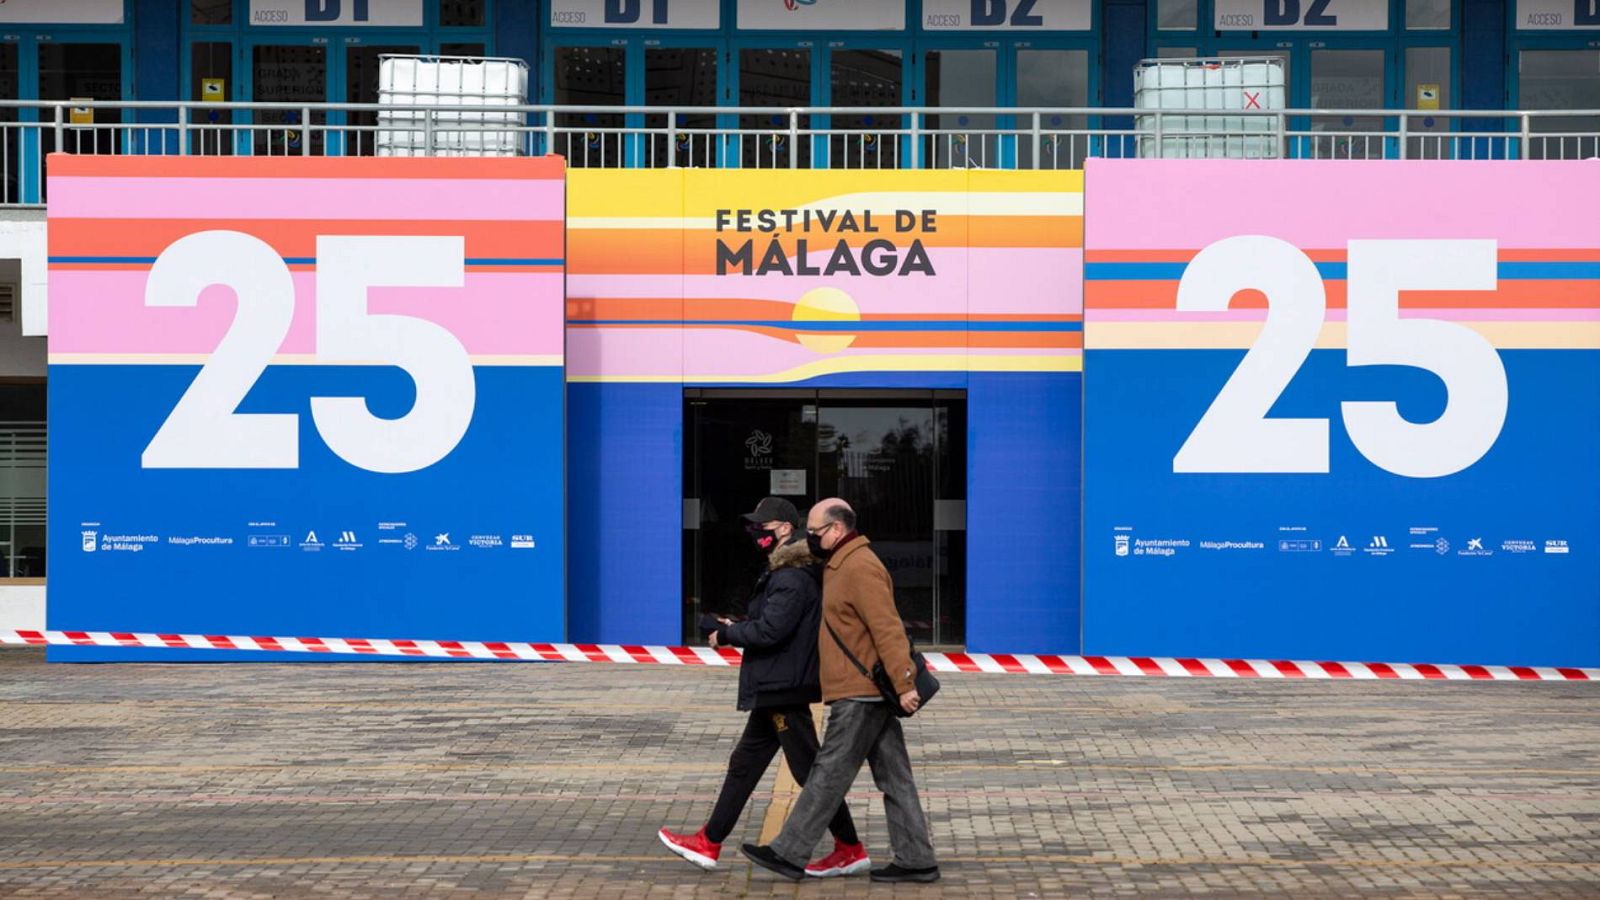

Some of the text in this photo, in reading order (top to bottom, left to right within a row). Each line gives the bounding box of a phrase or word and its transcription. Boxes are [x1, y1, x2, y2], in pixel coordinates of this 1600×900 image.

[254, 10, 288, 22] ACCESO
[552, 12, 586, 24] ACCESO
[926, 15, 960, 27] ACCESO
[1219, 15, 1253, 27] ACCESO
[1527, 14, 1562, 26] ACCESO
[716, 209, 937, 233] FESTIVAL DE
[716, 233, 936, 276] MÁLAGA
[141, 230, 476, 473] 25
[1173, 235, 1508, 479] 25
[102, 534, 158, 543] Ayuntamiento
[168, 536, 233, 546] MálagaProcultura
[1134, 539, 1190, 548] Ayuntamiento
[114, 542, 143, 552] Málaga
[1146, 547, 1175, 557] Málaga
[1200, 541, 1265, 551] MálagaProcultura
